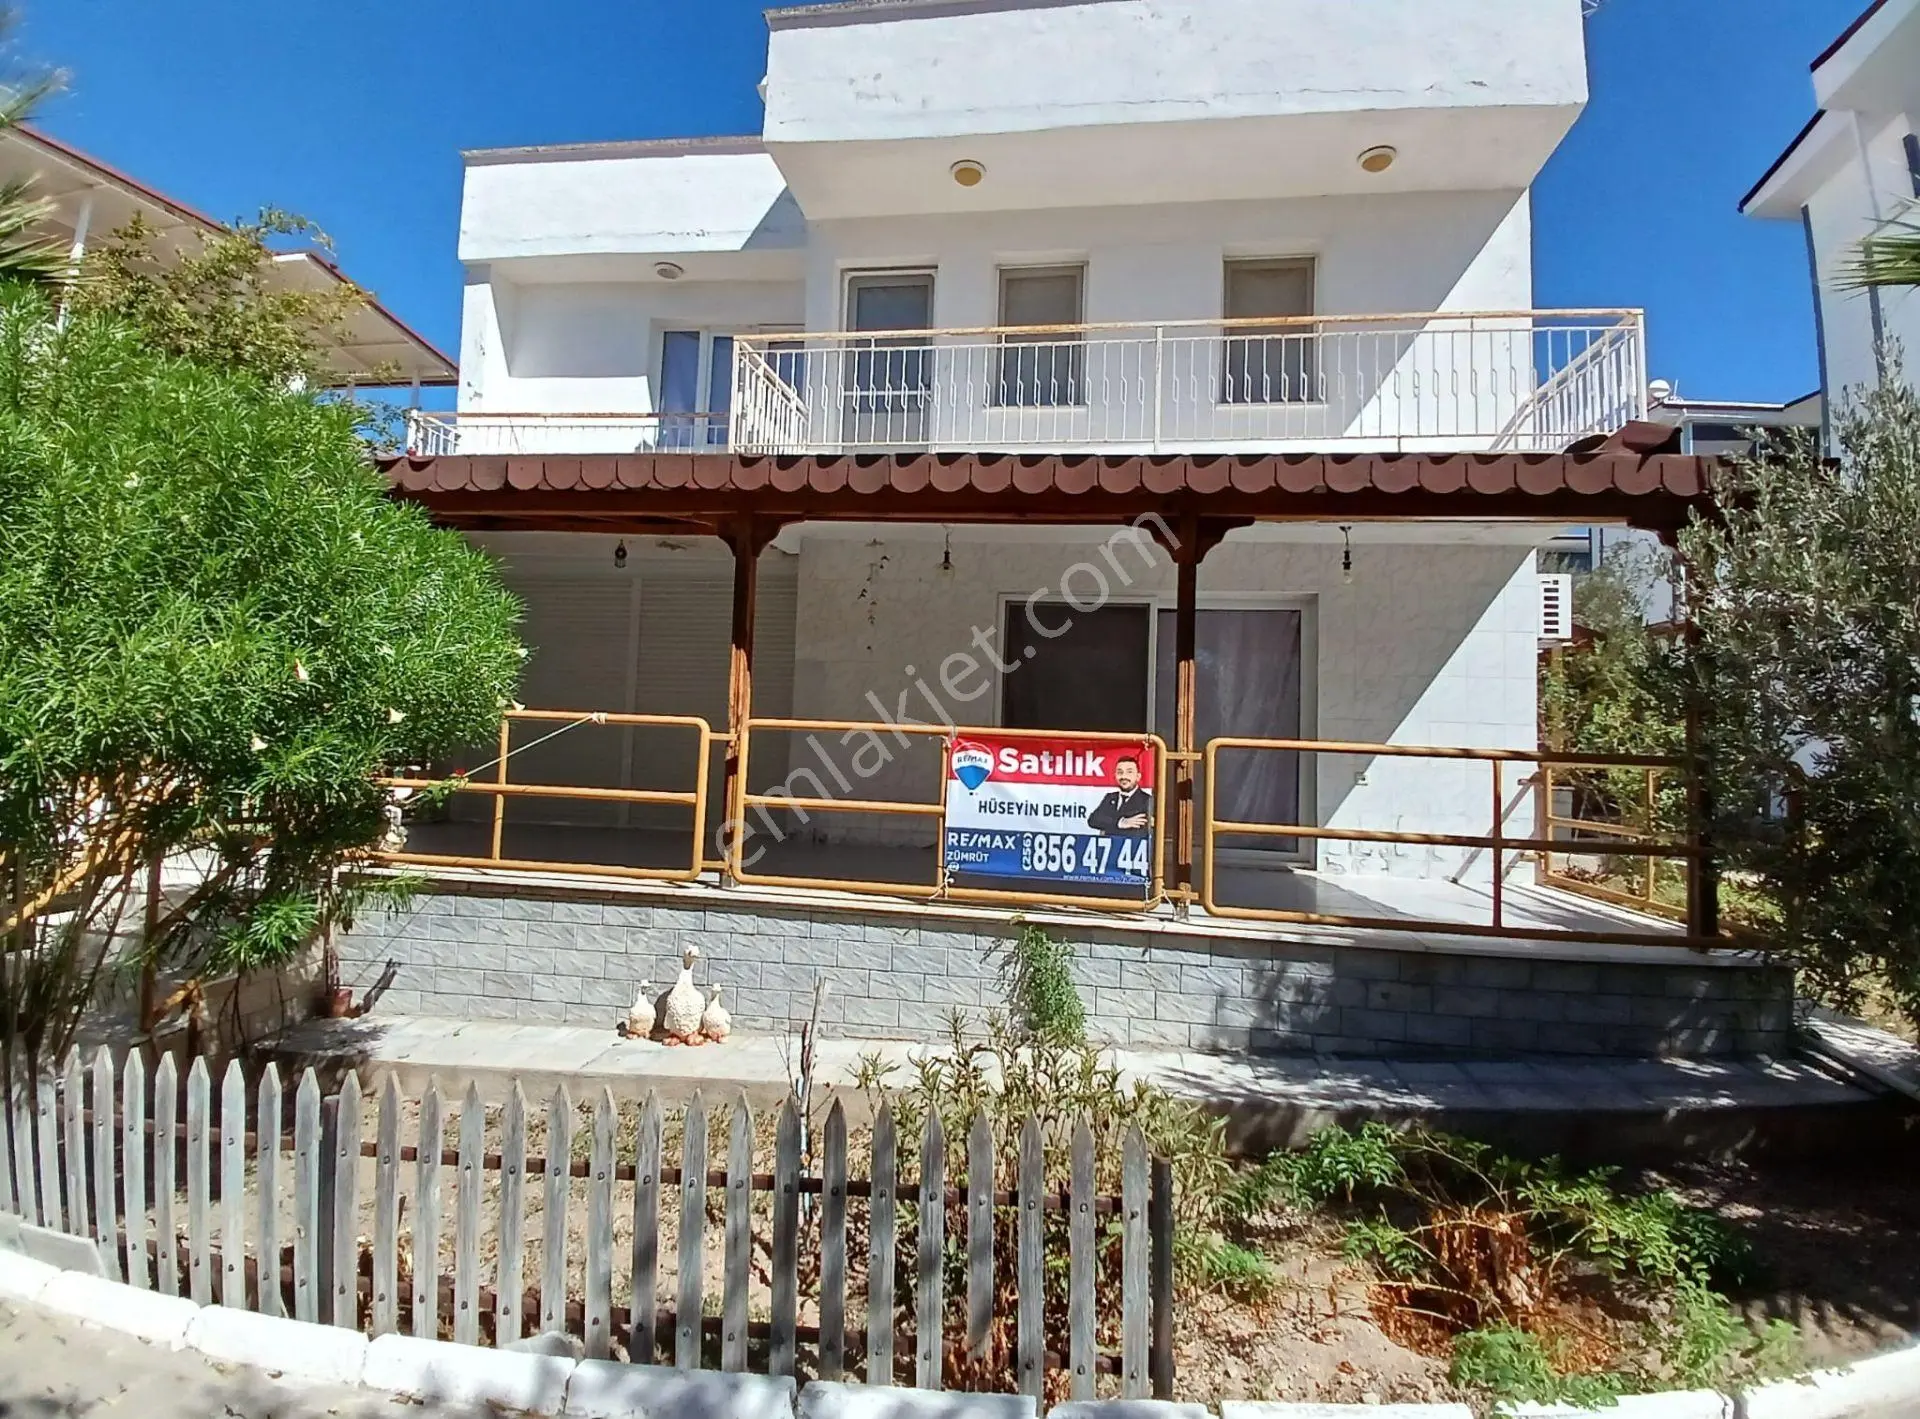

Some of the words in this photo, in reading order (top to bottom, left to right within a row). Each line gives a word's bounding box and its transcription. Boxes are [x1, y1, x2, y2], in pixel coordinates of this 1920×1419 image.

[997, 747, 1106, 777] Satılık
[978, 797, 1039, 816] HÜSEYİN
[1043, 802, 1087, 818] DEMİR
[947, 832, 1016, 850] RE/MAX
[1022, 832, 1033, 871] (256)
[1033, 833, 1076, 873] 856
[1082, 836, 1112, 875] 47
[1117, 838, 1149, 877] 44
